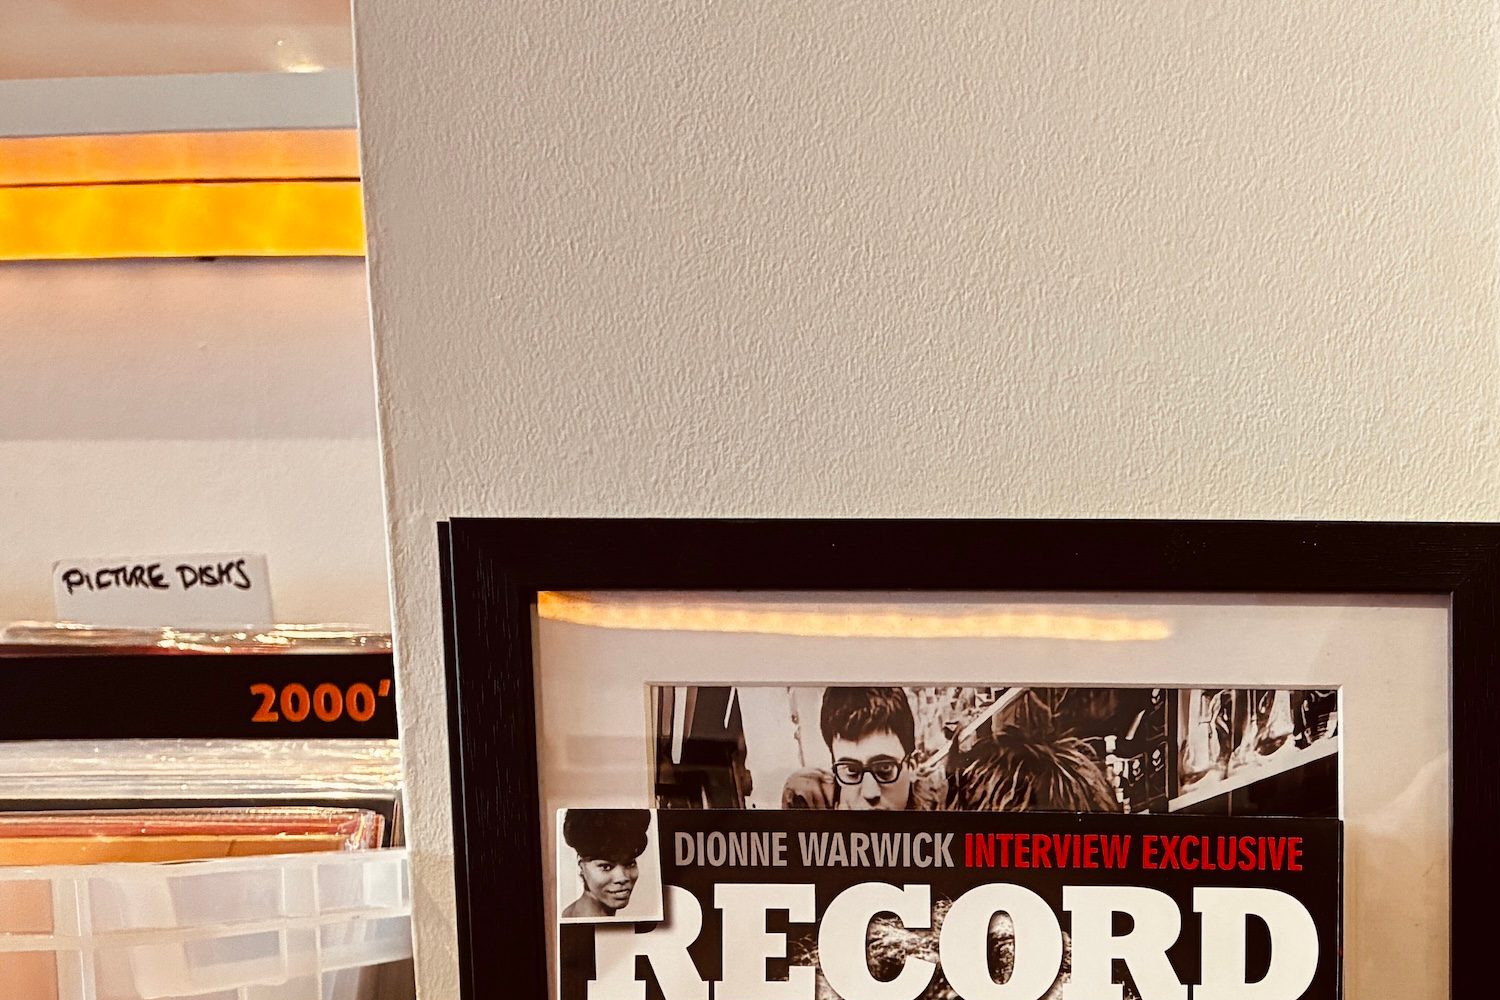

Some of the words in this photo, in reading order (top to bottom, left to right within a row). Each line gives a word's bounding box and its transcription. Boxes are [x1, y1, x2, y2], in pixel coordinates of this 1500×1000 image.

[62, 564, 169, 594] PICTURE
[176, 559, 251, 590] DISKS
[674, 831, 788, 868] DIONNE
[798, 831, 955, 868] WARWICK
[965, 833, 1130, 869] INTERVIEW
[1143, 834, 1303, 871] EXCLUSIVE
